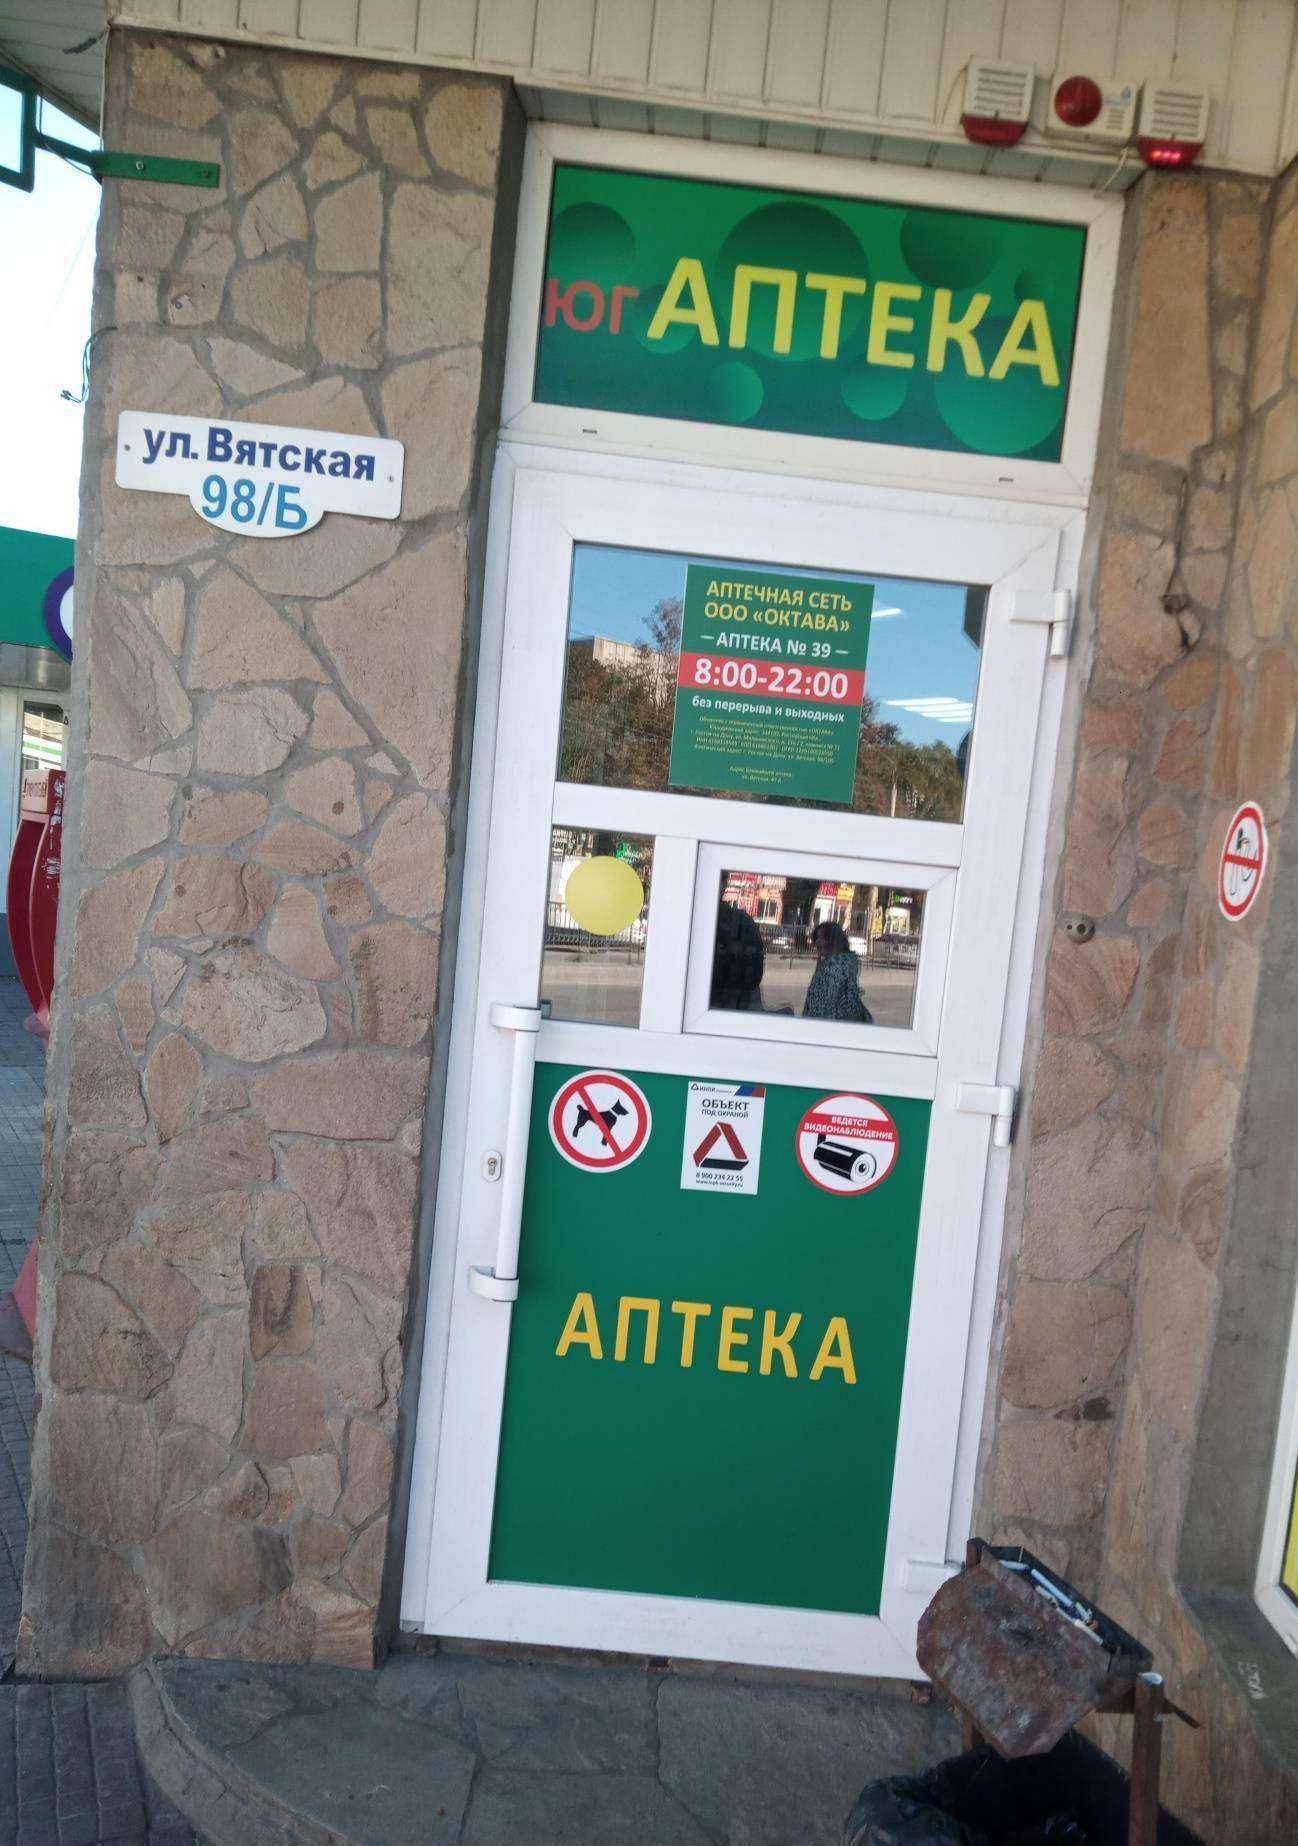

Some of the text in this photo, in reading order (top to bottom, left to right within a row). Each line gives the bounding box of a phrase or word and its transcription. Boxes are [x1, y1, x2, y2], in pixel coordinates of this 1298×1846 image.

[545, 257, 1060, 387] ЮГ АПТЕКА
[142, 426, 376, 481] ул. Вятская
[201, 474, 308, 530] 98/Б
[706, 580, 852, 612] АПТЕЧНАЯ СЕТЬ
[704, 602, 850, 632] ООО «ОКТАВА»
[716, 632, 831, 658] АПТЕКА № 39
[694, 658, 848, 699] 8:00-22:00
[692, 695, 845, 723] без перерыва и выходных
[701, 1109, 749, 1118] ПОД ОХРАНОЙ
[702, 1099, 750, 1111] ОБЪЕКТ
[804, 1122, 893, 1140] ВИДЕОНАБЛЮДЕНИЕ
[555, 1292, 857, 1384] АПТЕКА
